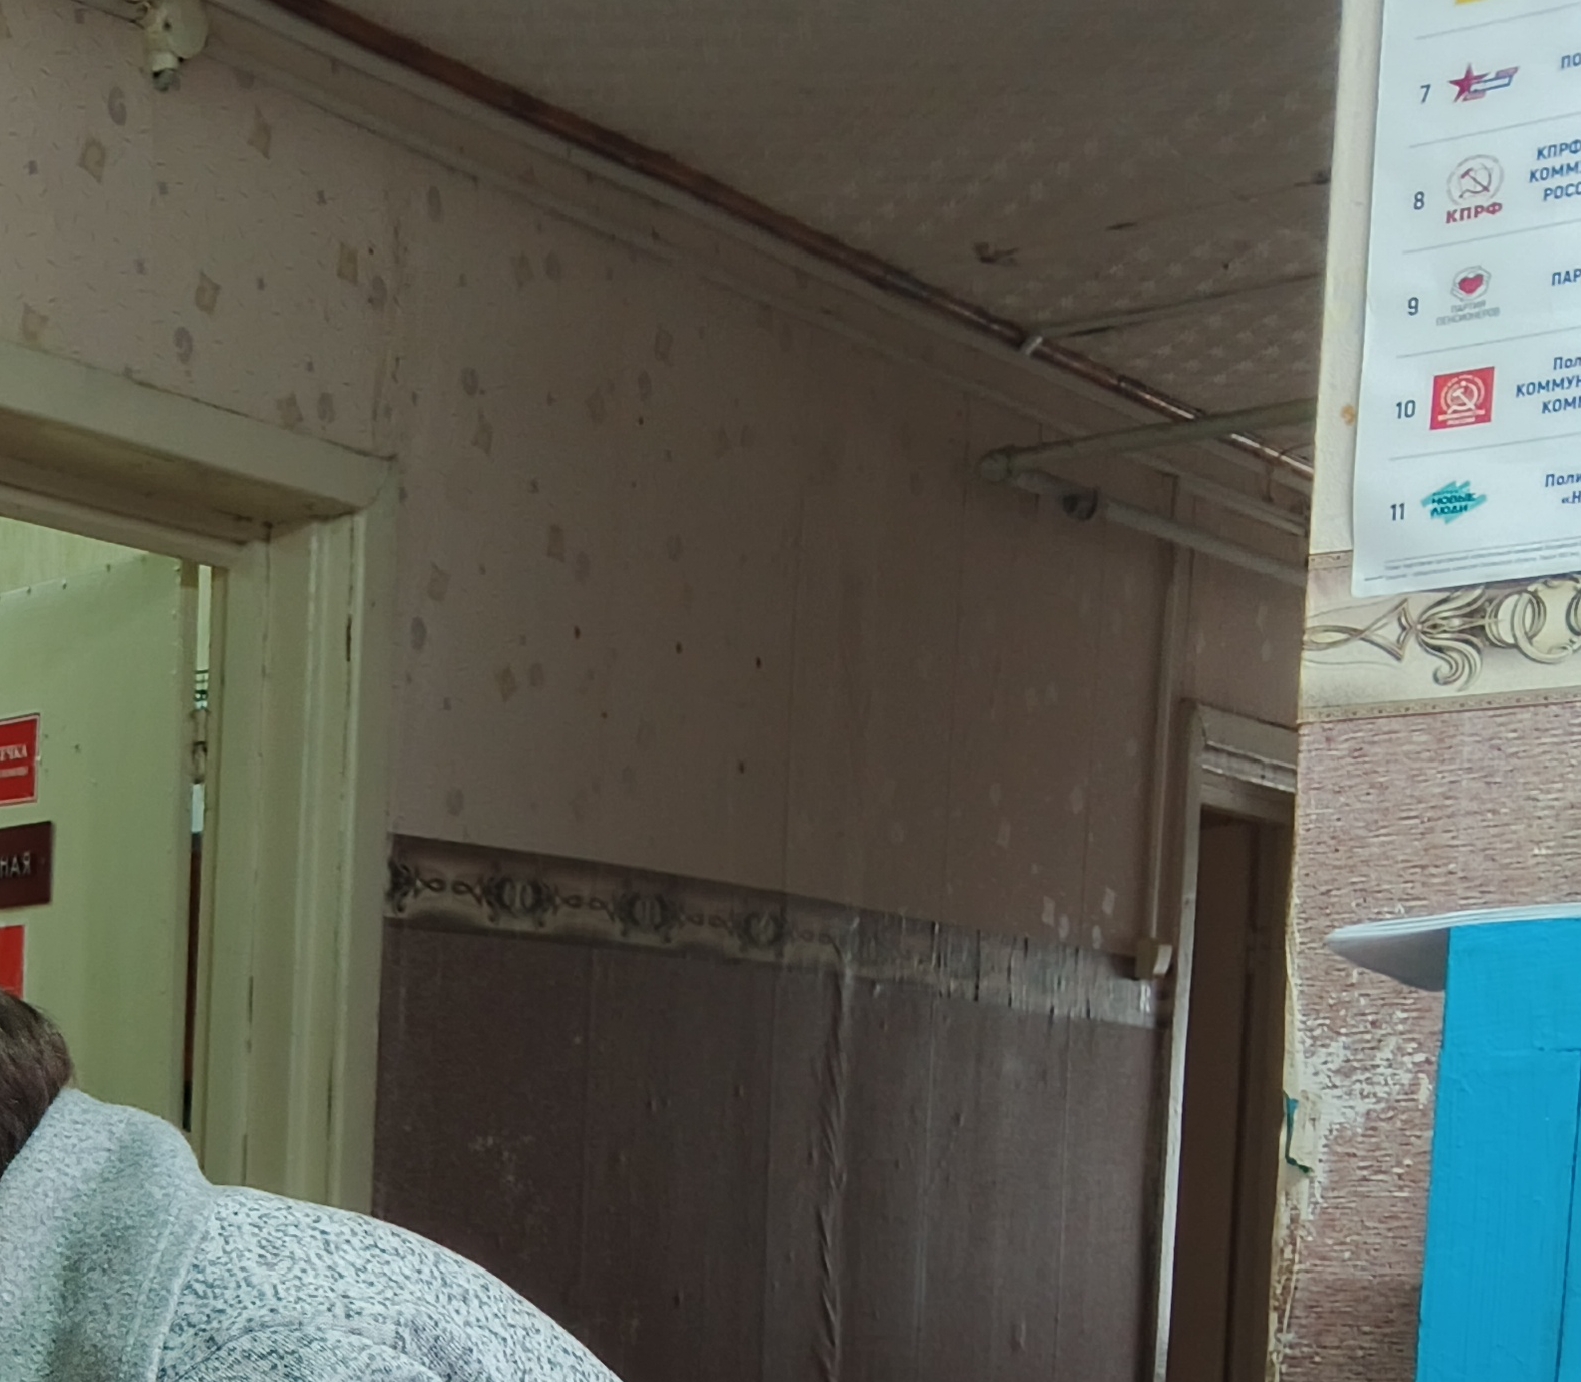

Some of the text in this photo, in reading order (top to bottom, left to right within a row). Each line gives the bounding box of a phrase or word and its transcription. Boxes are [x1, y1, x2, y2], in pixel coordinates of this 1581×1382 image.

[1420, 84, 1431, 104] 7
[1536, 139, 1581, 160] КПРФ
[1529, 160, 1581, 183] КОММ
[1413, 191, 1425, 210] 8
[1445, 201, 1503, 224] КПРФ
[1551, 268, 1581, 286] ПАР
[1407, 297, 1419, 316] 9
[1396, 400, 1416, 419] 10
[1390, 502, 1405, 521] 11
